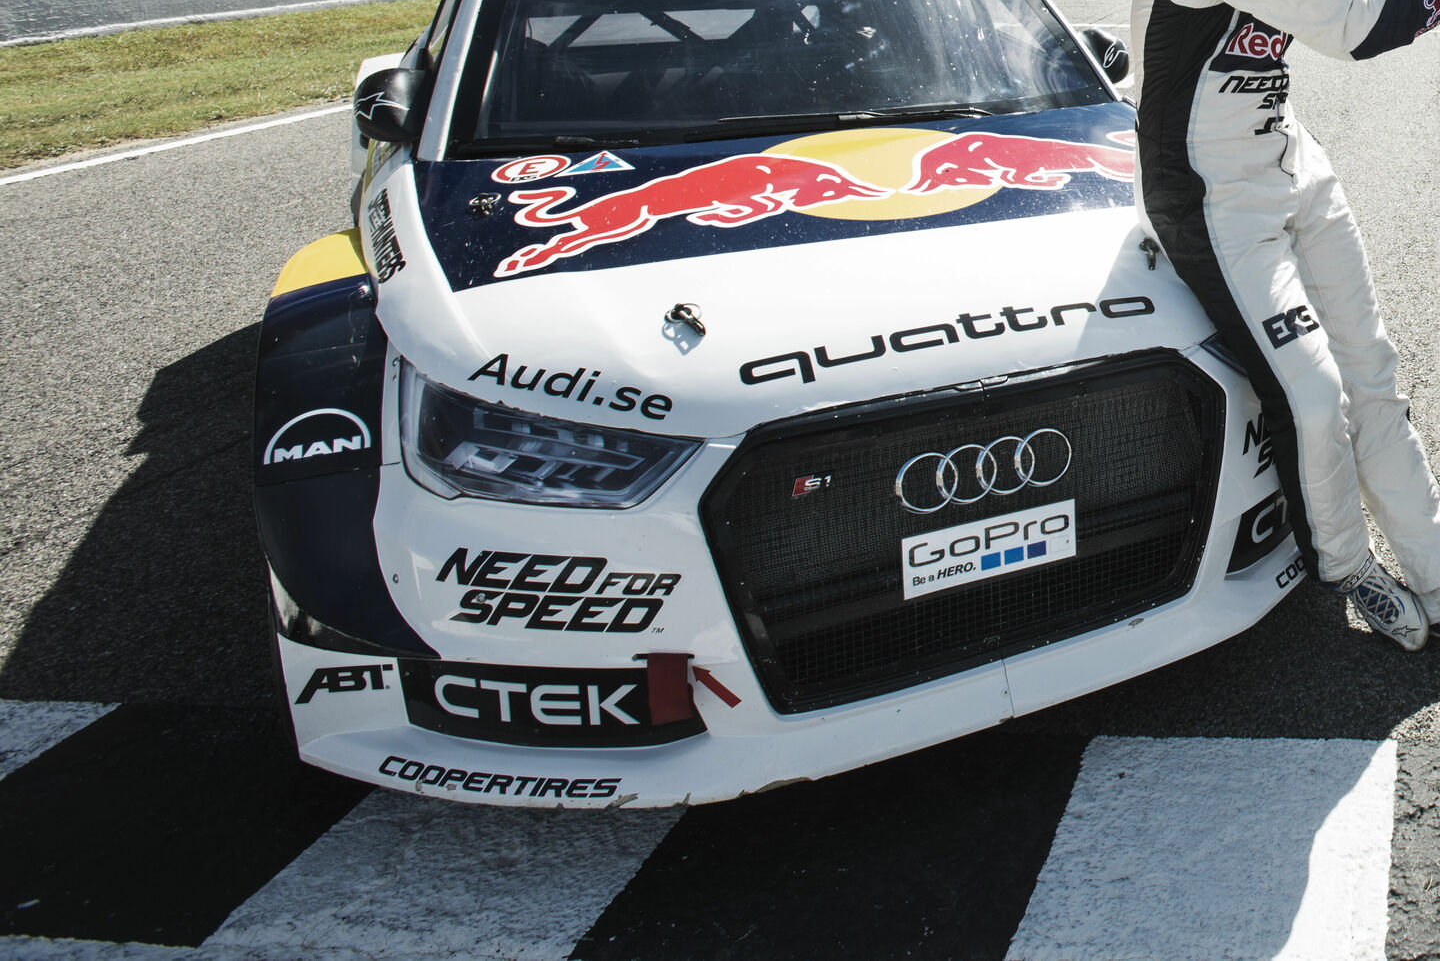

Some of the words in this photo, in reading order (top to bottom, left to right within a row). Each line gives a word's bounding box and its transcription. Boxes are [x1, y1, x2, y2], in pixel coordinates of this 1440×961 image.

[1225, 22, 1289, 61] Red
[518, 161, 546, 176] E
[738, 296, 1156, 386] quattro
[469, 354, 674, 420] Audi.se
[274, 435, 363, 464] MAN
[804, 473, 831, 492] S1
[908, 513, 1070, 568] GoPro
[435, 547, 608, 594] NEED
[595, 572, 682, 596] FOR
[912, 576, 926, 586] Be
[937, 561, 977, 580] HERO.
[449, 589, 664, 633] SPEED
[294, 664, 394, 705] ABT
[434, 675, 642, 726] CTEK
